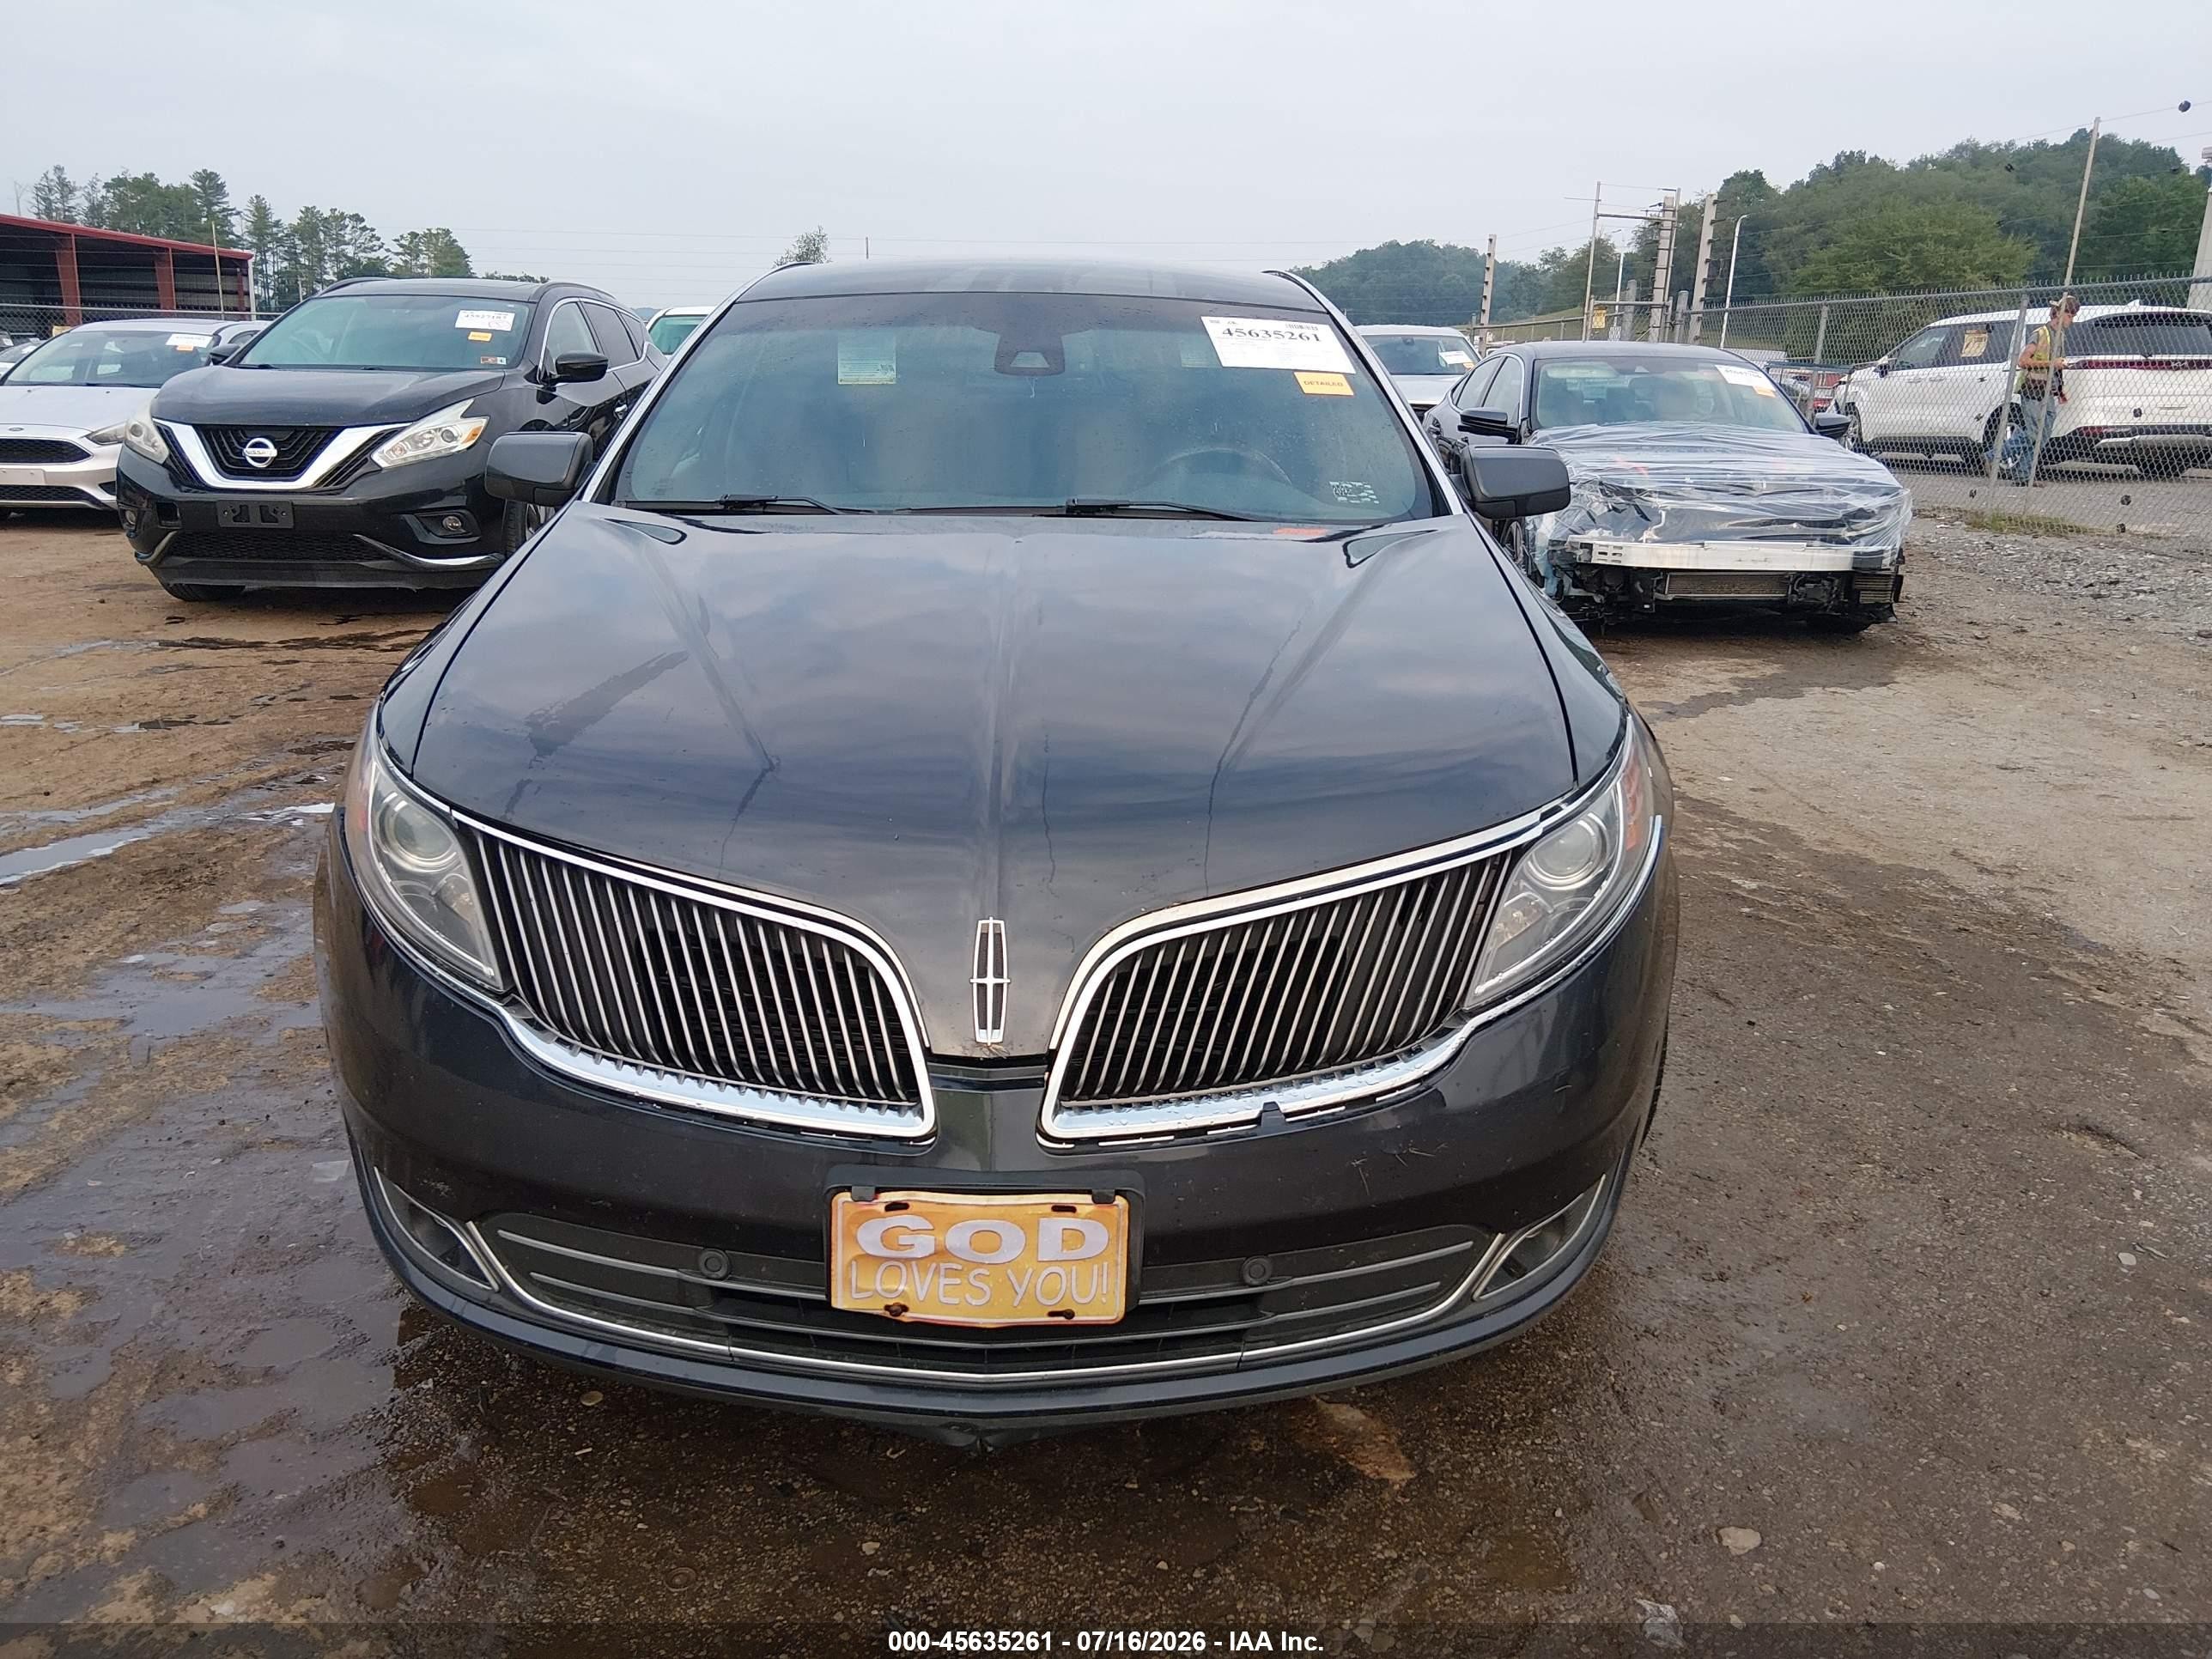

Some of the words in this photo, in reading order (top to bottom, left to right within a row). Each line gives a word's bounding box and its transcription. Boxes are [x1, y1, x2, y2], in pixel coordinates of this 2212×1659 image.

[1223, 328, 1321, 342] 45635261
[856, 1214, 1109, 1264] GOD
[851, 1260, 992, 1306] LOVES
[1006, 1262, 1108, 1307] YOU!
